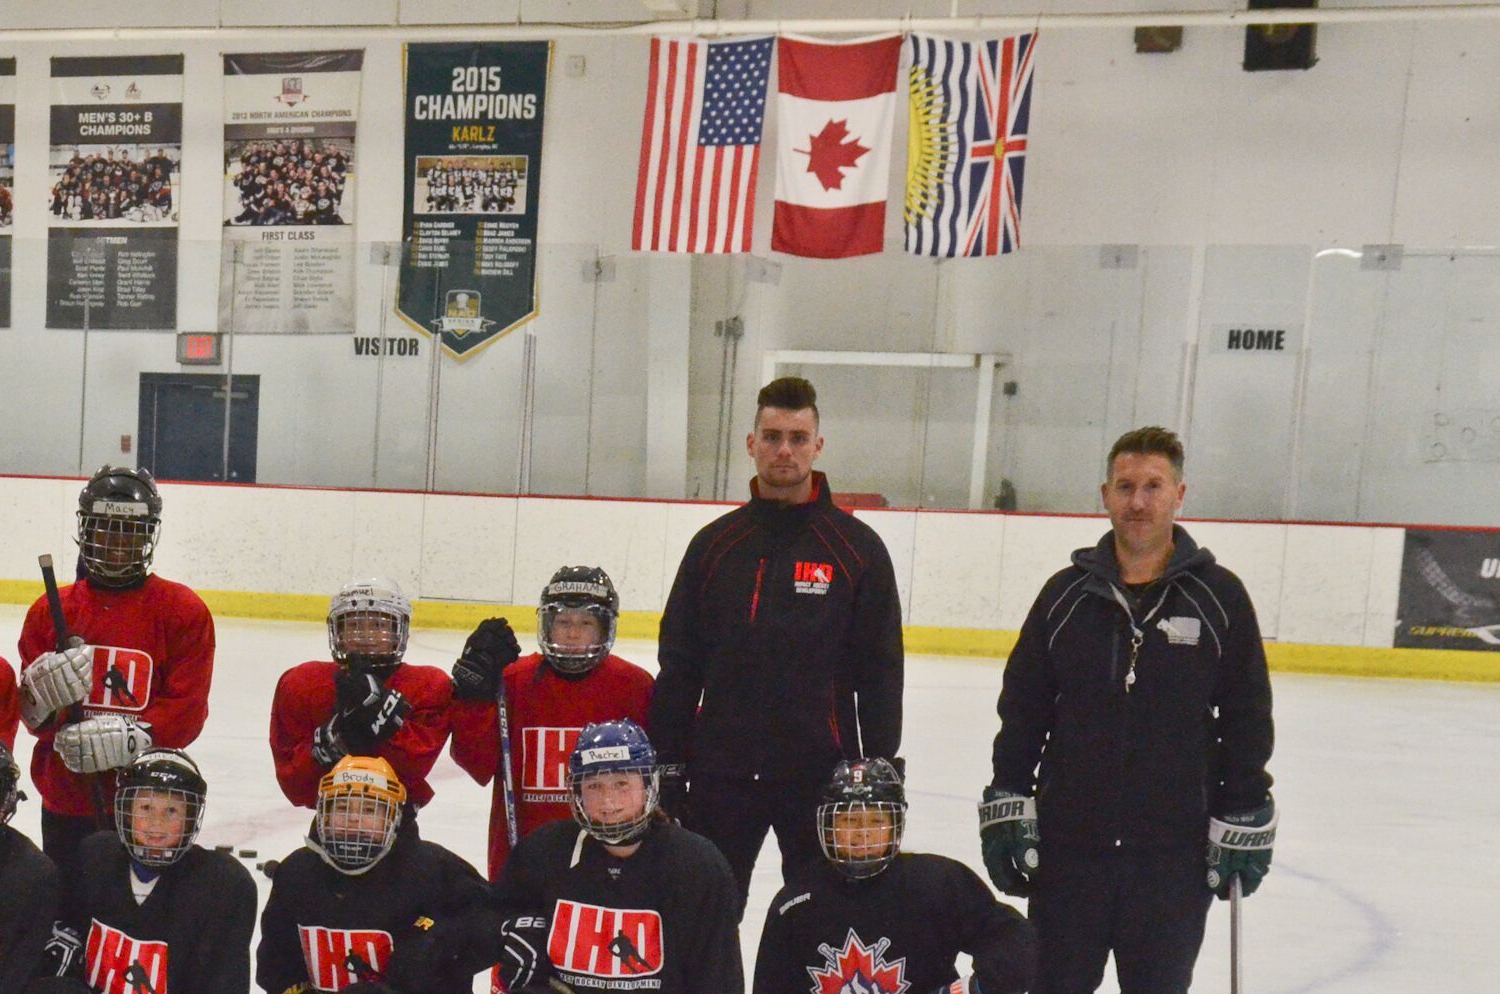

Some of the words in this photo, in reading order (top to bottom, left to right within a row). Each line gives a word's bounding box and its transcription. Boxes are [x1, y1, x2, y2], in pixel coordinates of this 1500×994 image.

[452, 66, 501, 92] 2015
[415, 94, 537, 120] CHAMPIONS
[78, 112, 116, 124] MEN'S
[119, 111, 141, 123] 30+
[144, 111, 153, 122] B
[274, 111, 309, 119] AMERICAN
[311, 109, 351, 118] CHAMPIONS
[80, 124, 150, 136] CHAMPIONS
[452, 126, 496, 142] KARLZ
[262, 231, 284, 240] FIRST
[288, 231, 315, 240] CLASS
[1228, 329, 1285, 351] HOME
[187, 336, 212, 358] EXIT
[105, 502, 135, 515] Macy
[794, 561, 834, 583] IHD
[340, 588, 374, 599] Samuel
[554, 583, 600, 593] GRAHAM
[589, 750, 624, 760] Rachel
[150, 771, 178, 780] CCM
[342, 772, 375, 783] Brody
[547, 898, 664, 979] IHD
[297, 923, 394, 993] IHD
[575, 975, 606, 989] HOCKEY
[607, 980, 662, 991] DEVELOPMENT
